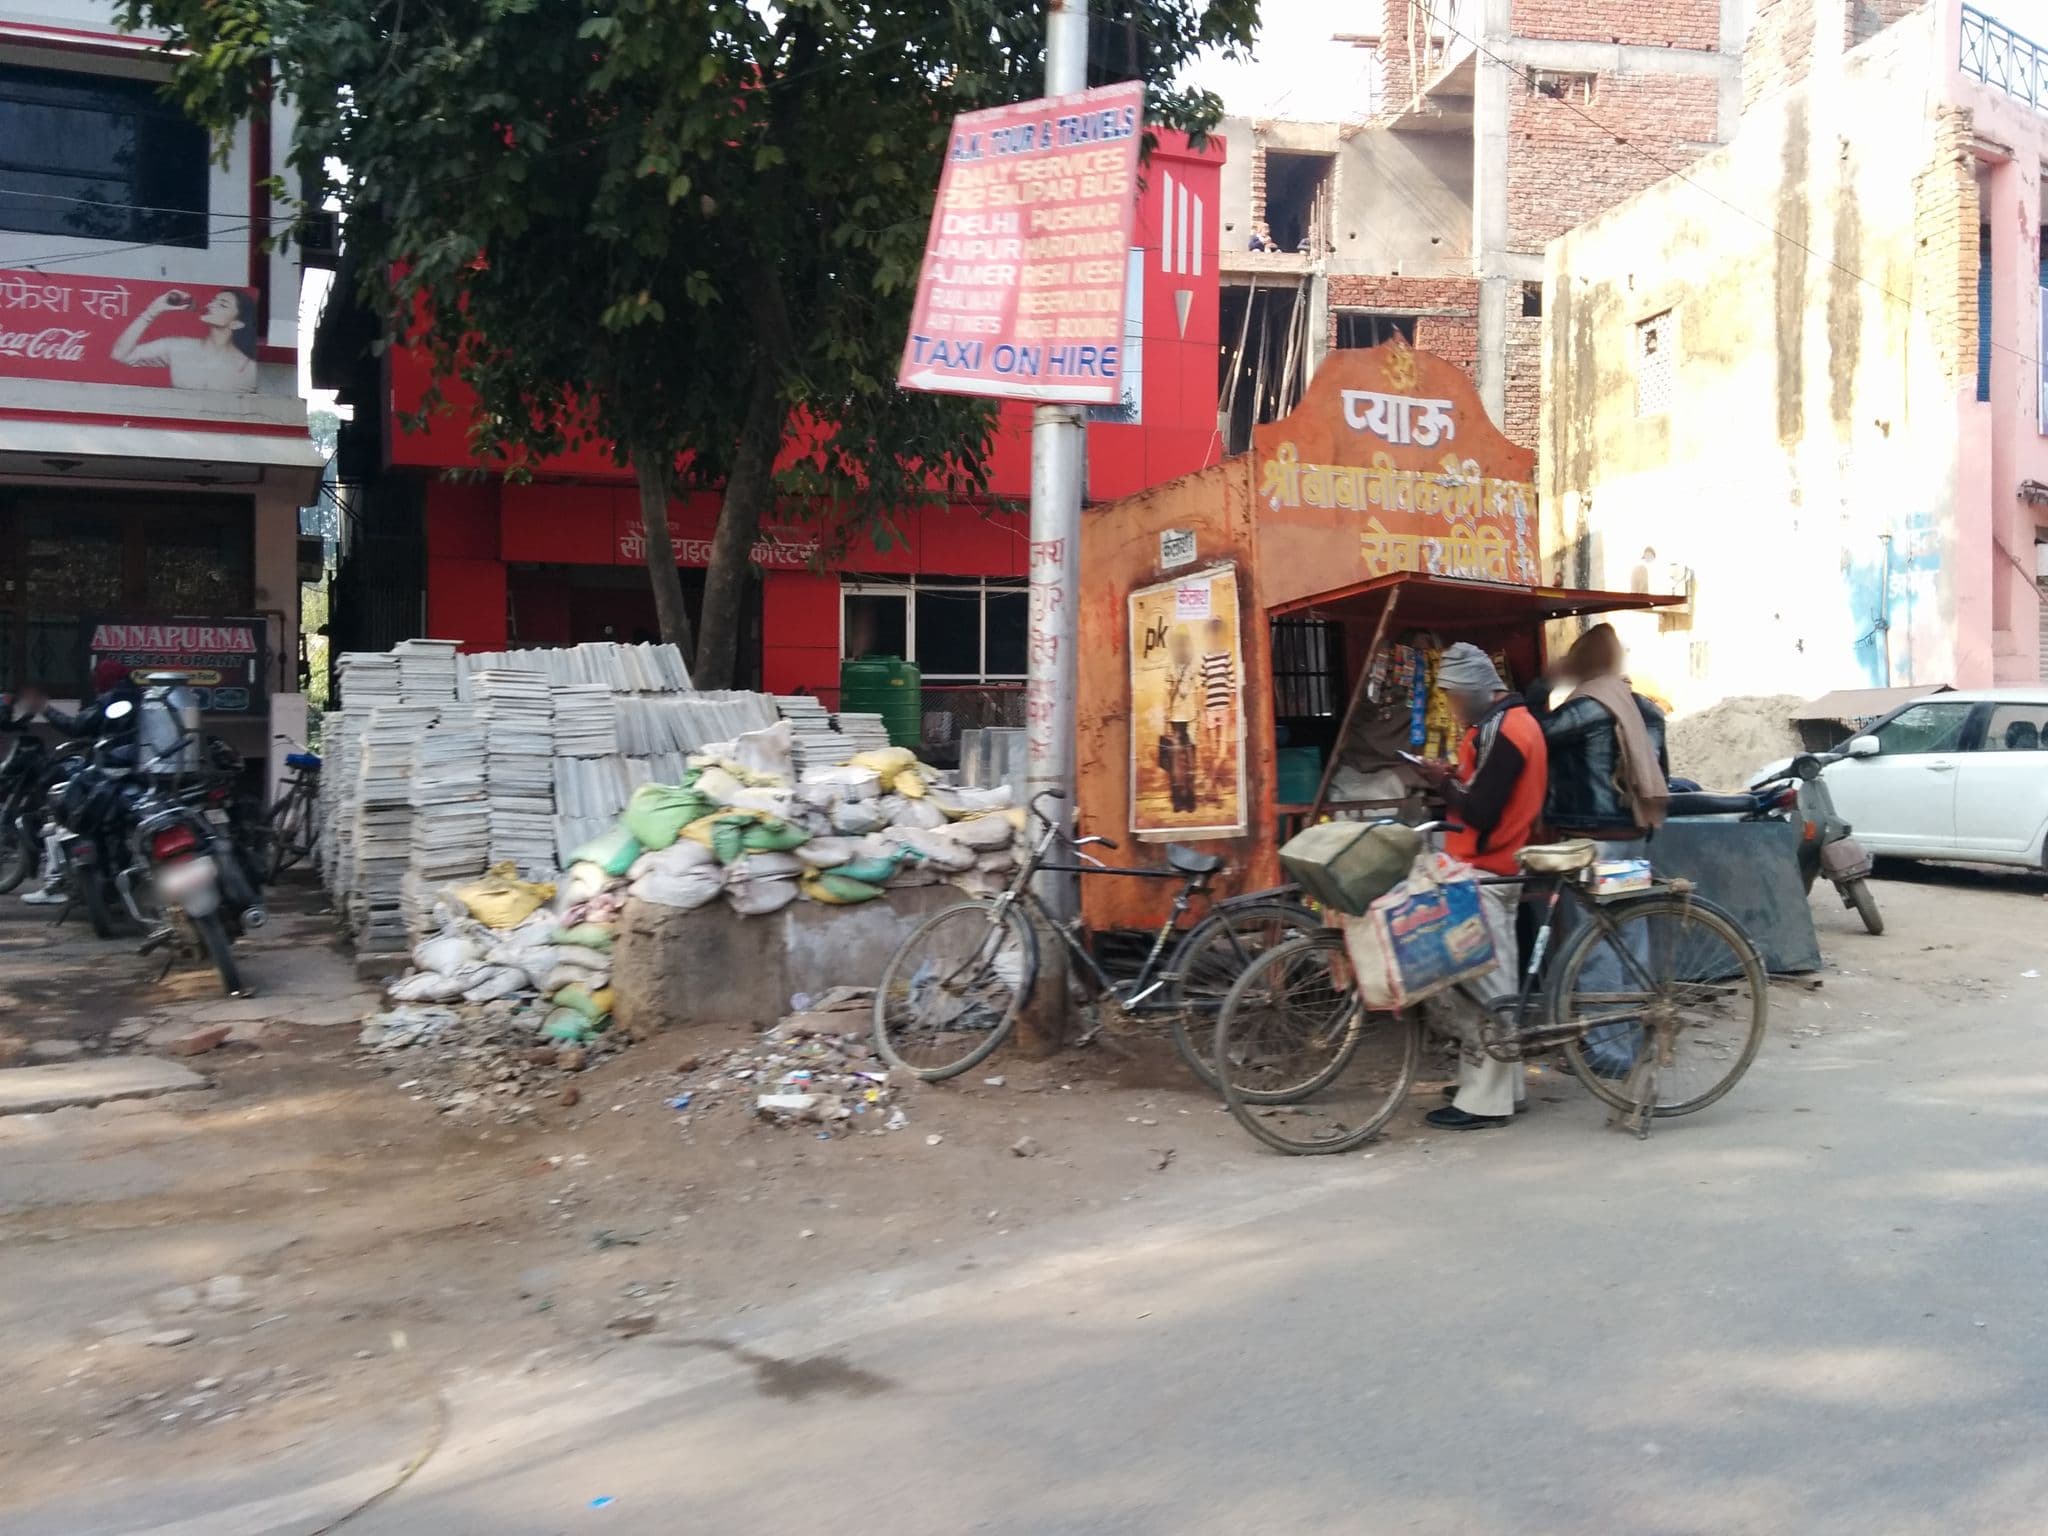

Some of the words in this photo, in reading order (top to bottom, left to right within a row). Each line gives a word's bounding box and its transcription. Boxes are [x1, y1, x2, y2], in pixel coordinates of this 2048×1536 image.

[990, 123, 1036, 156] TOUR
[1040, 119, 1054, 150] &
[1058, 105, 1136, 147] TRAVELS
[949, 162, 1011, 189] DAILY
[1015, 147, 1126, 181] SERVICES
[1080, 171, 1130, 198] BUS
[941, 212, 1020, 236] DELHI
[1030, 203, 1121, 231] PUSHKAR
[928, 238, 1021, 260] JAIPUR
[925, 262, 1017, 286] AJMER
[80, 284, 132, 320] रहो
[911, 334, 984, 372] TAXI
[991, 343, 1042, 377] ON
[1047, 345, 1119, 378] HIRE
[1340, 389, 1456, 447] प्याऊ
[1360, 516, 1421, 577] सेवा
[90, 624, 257, 654] ANNAPURNA
[1143, 615, 1169, 659] pk
